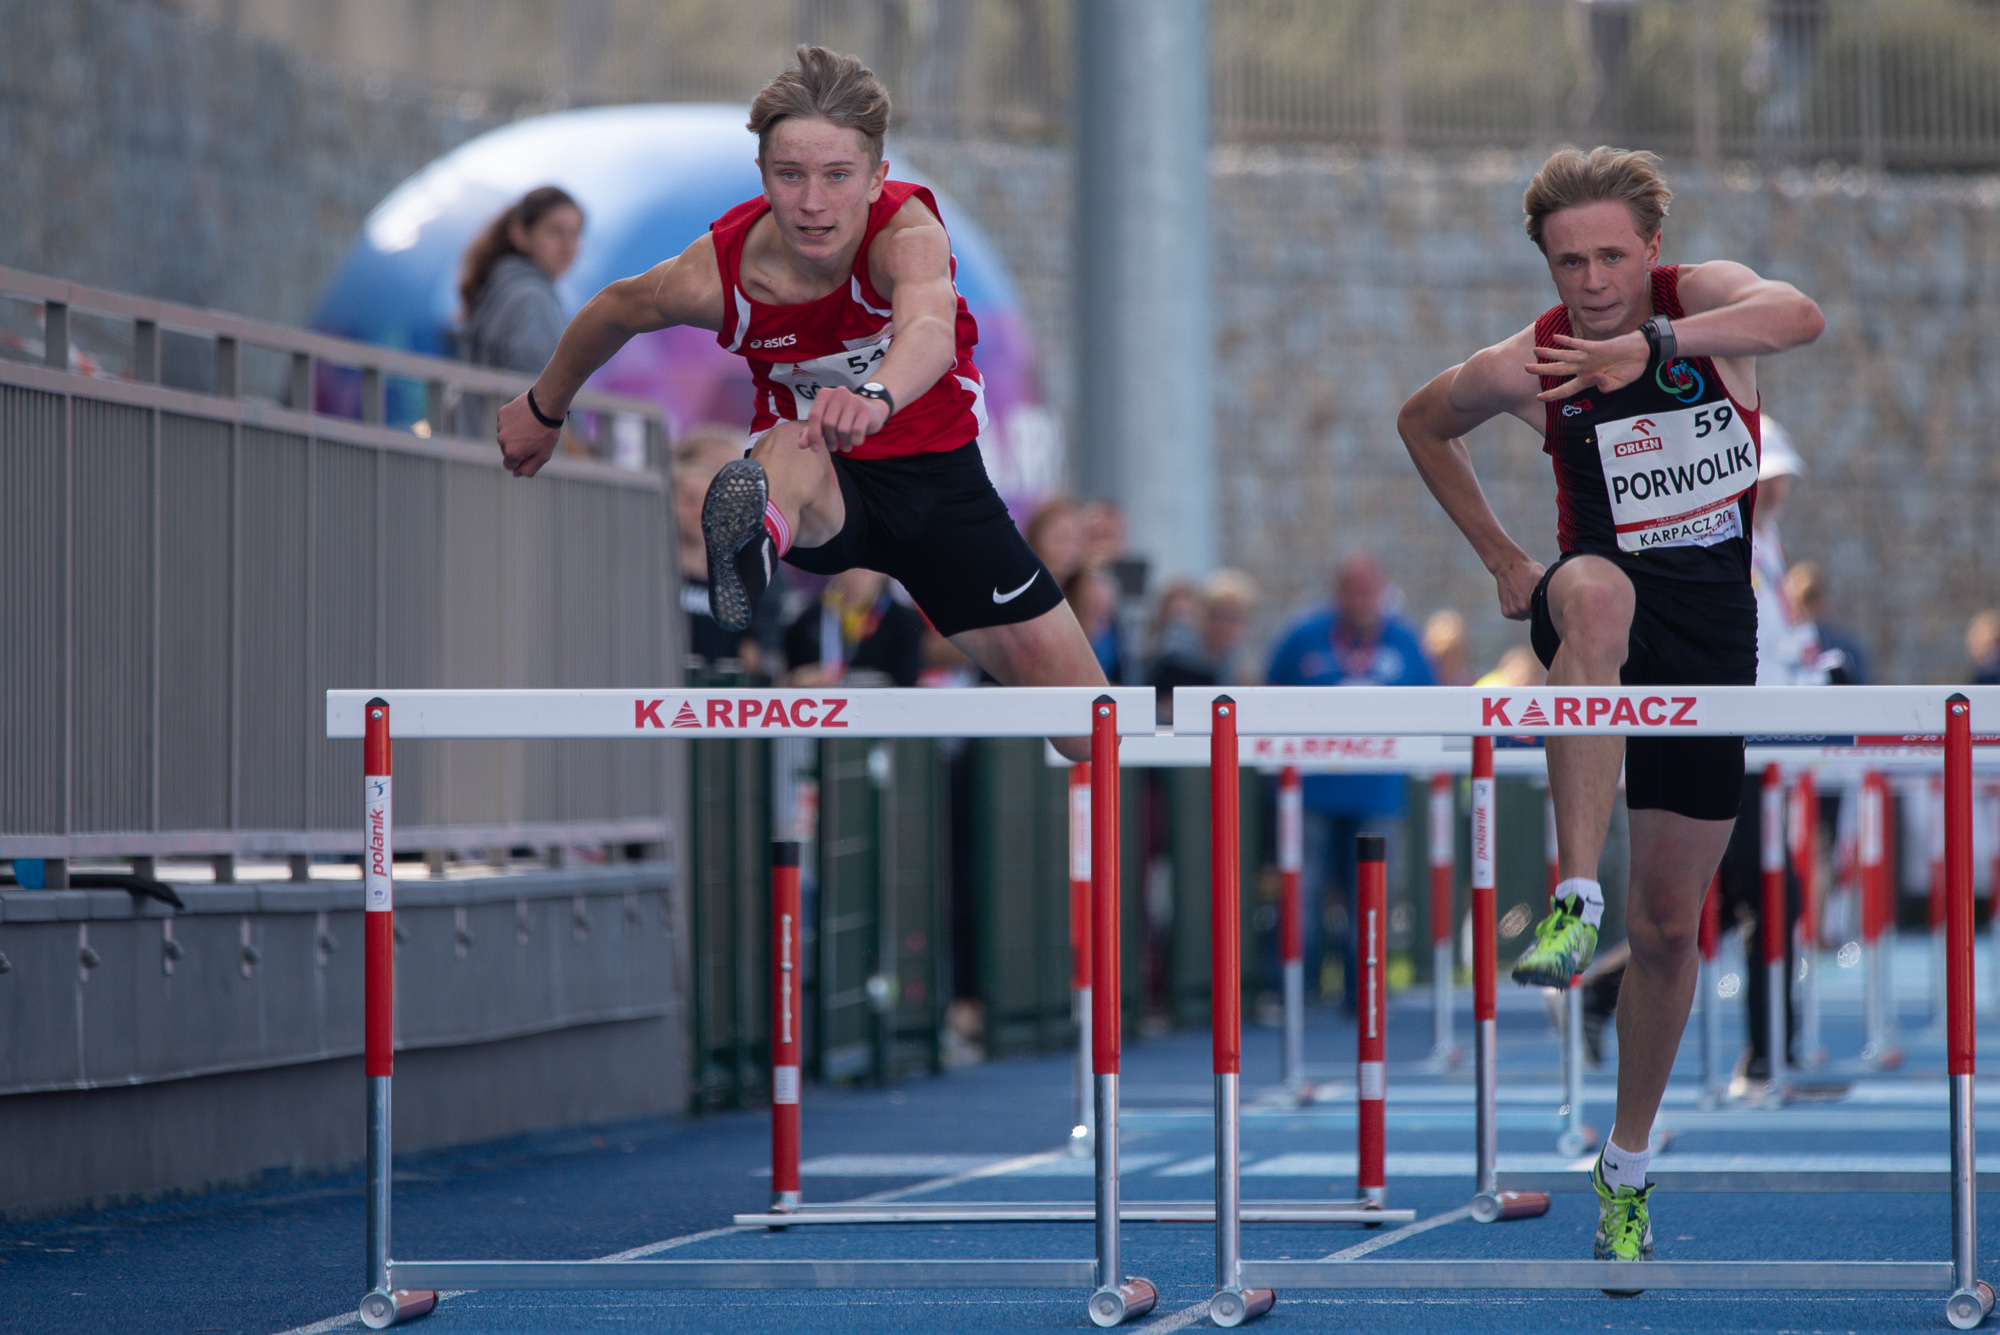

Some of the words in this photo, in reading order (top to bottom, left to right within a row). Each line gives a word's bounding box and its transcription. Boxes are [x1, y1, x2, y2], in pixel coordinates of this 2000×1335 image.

[764, 334, 797, 348] asics
[1694, 406, 1733, 438] 59
[1616, 438, 1660, 456] ORLEN
[1612, 442, 1753, 504] PORWOLIK
[1640, 517, 1712, 546] KARPACZ
[635, 698, 848, 728] KARPACZ
[1482, 697, 1697, 727] KARPACZ
[369, 808, 387, 877] polanik
